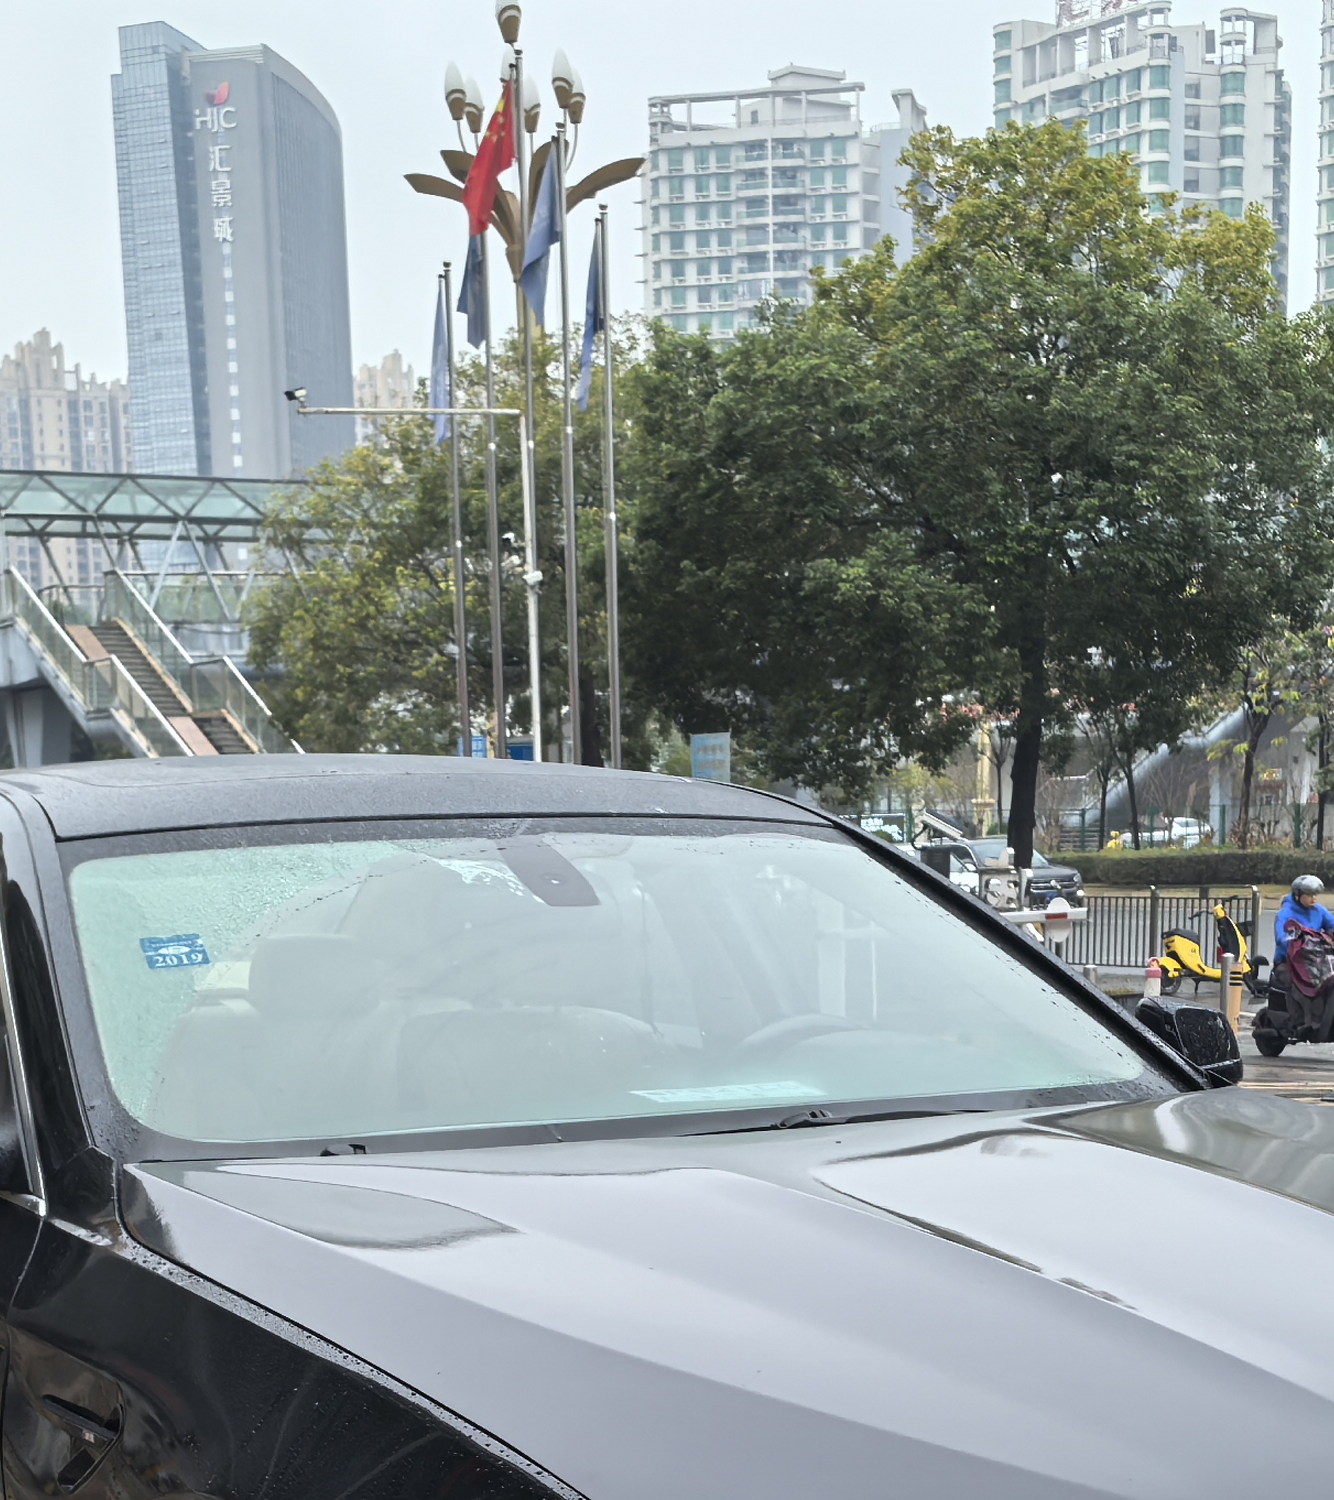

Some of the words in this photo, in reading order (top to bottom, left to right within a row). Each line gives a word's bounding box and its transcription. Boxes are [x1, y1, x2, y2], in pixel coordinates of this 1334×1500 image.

[195, 107, 237, 132] HJC
[209, 145, 234, 242] 汇景城
[154, 952, 203, 967] 2019
